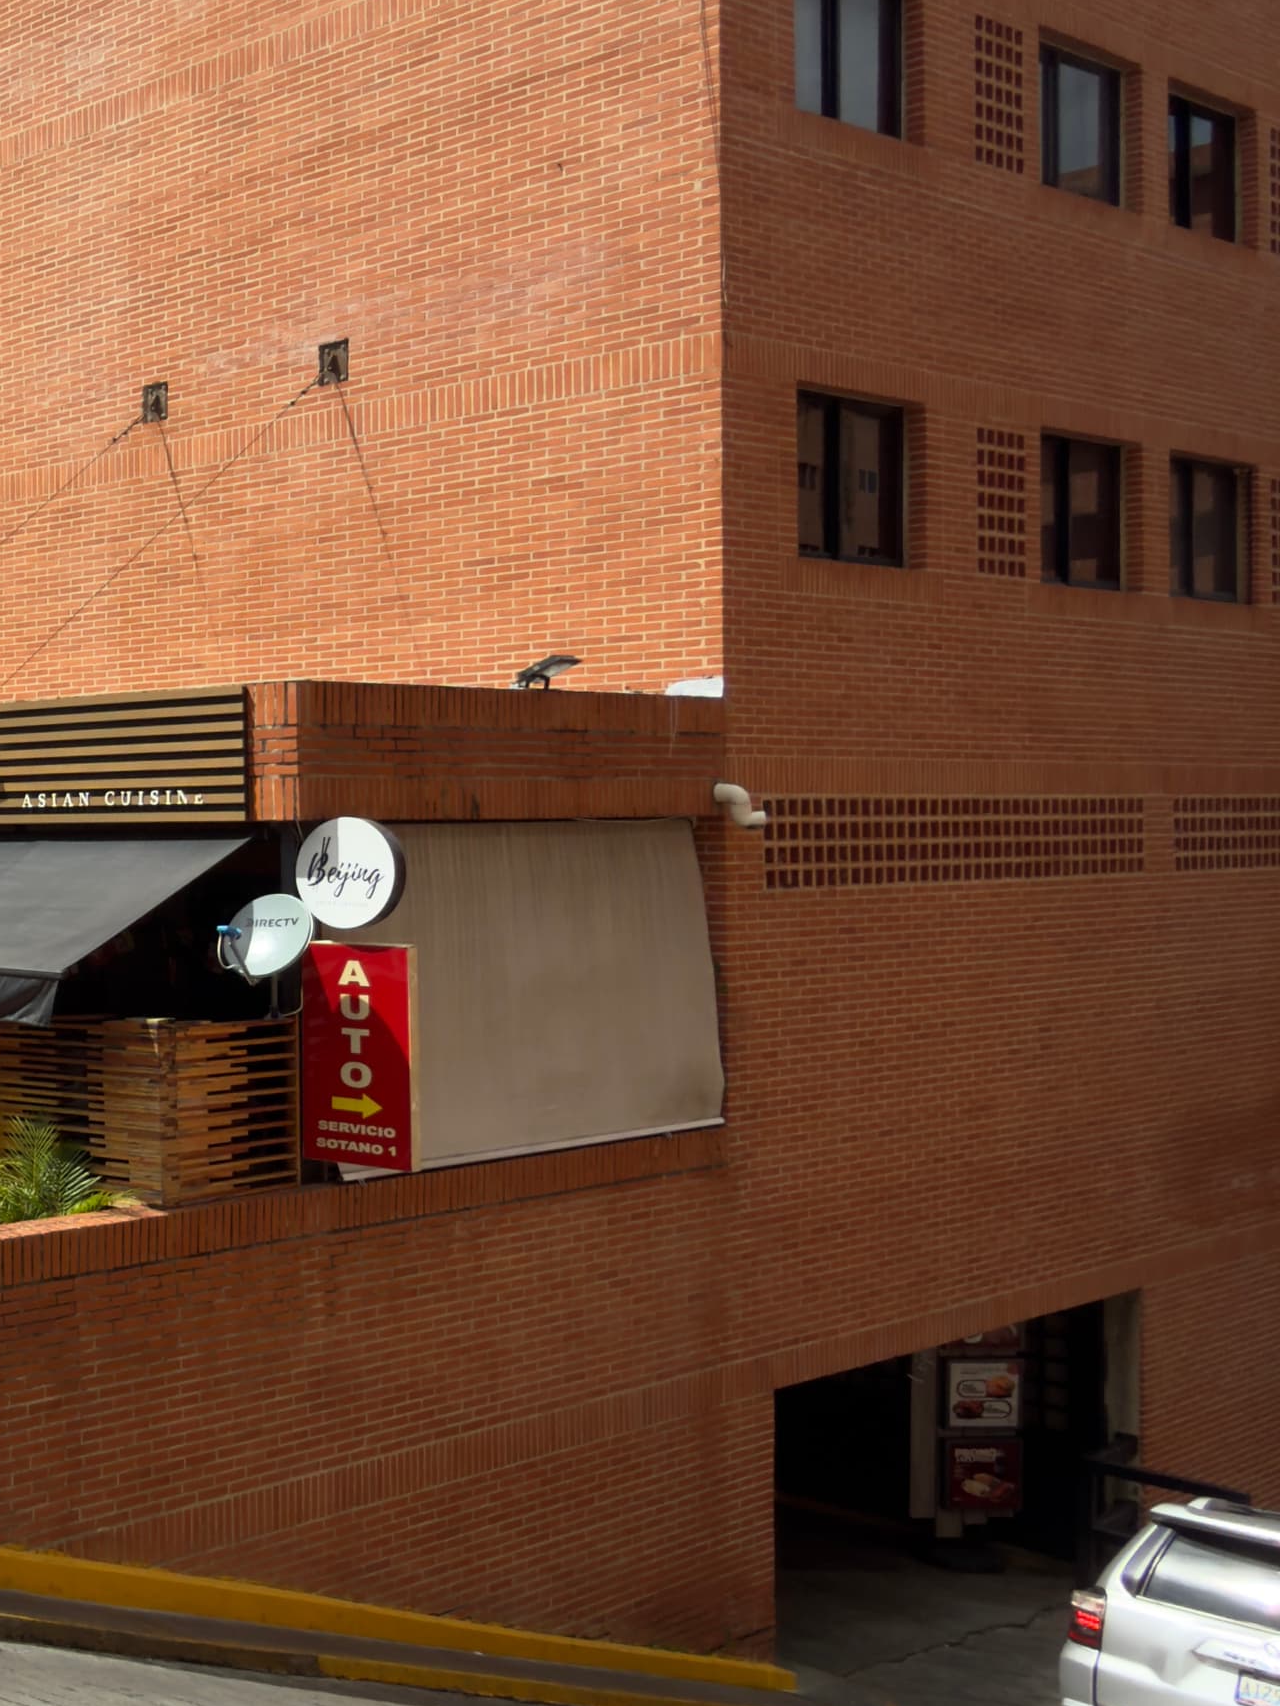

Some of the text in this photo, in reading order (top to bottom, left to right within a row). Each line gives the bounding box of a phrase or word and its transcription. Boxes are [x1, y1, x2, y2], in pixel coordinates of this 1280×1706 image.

[22, 790, 204, 808] ASIAN CUISINE
[307, 837, 385, 899] Beijing
[245, 917, 300, 928] DIRECTV
[317, 1120, 396, 1139] SERVICIO
[315, 1137, 397, 1157] SOTANO 1
